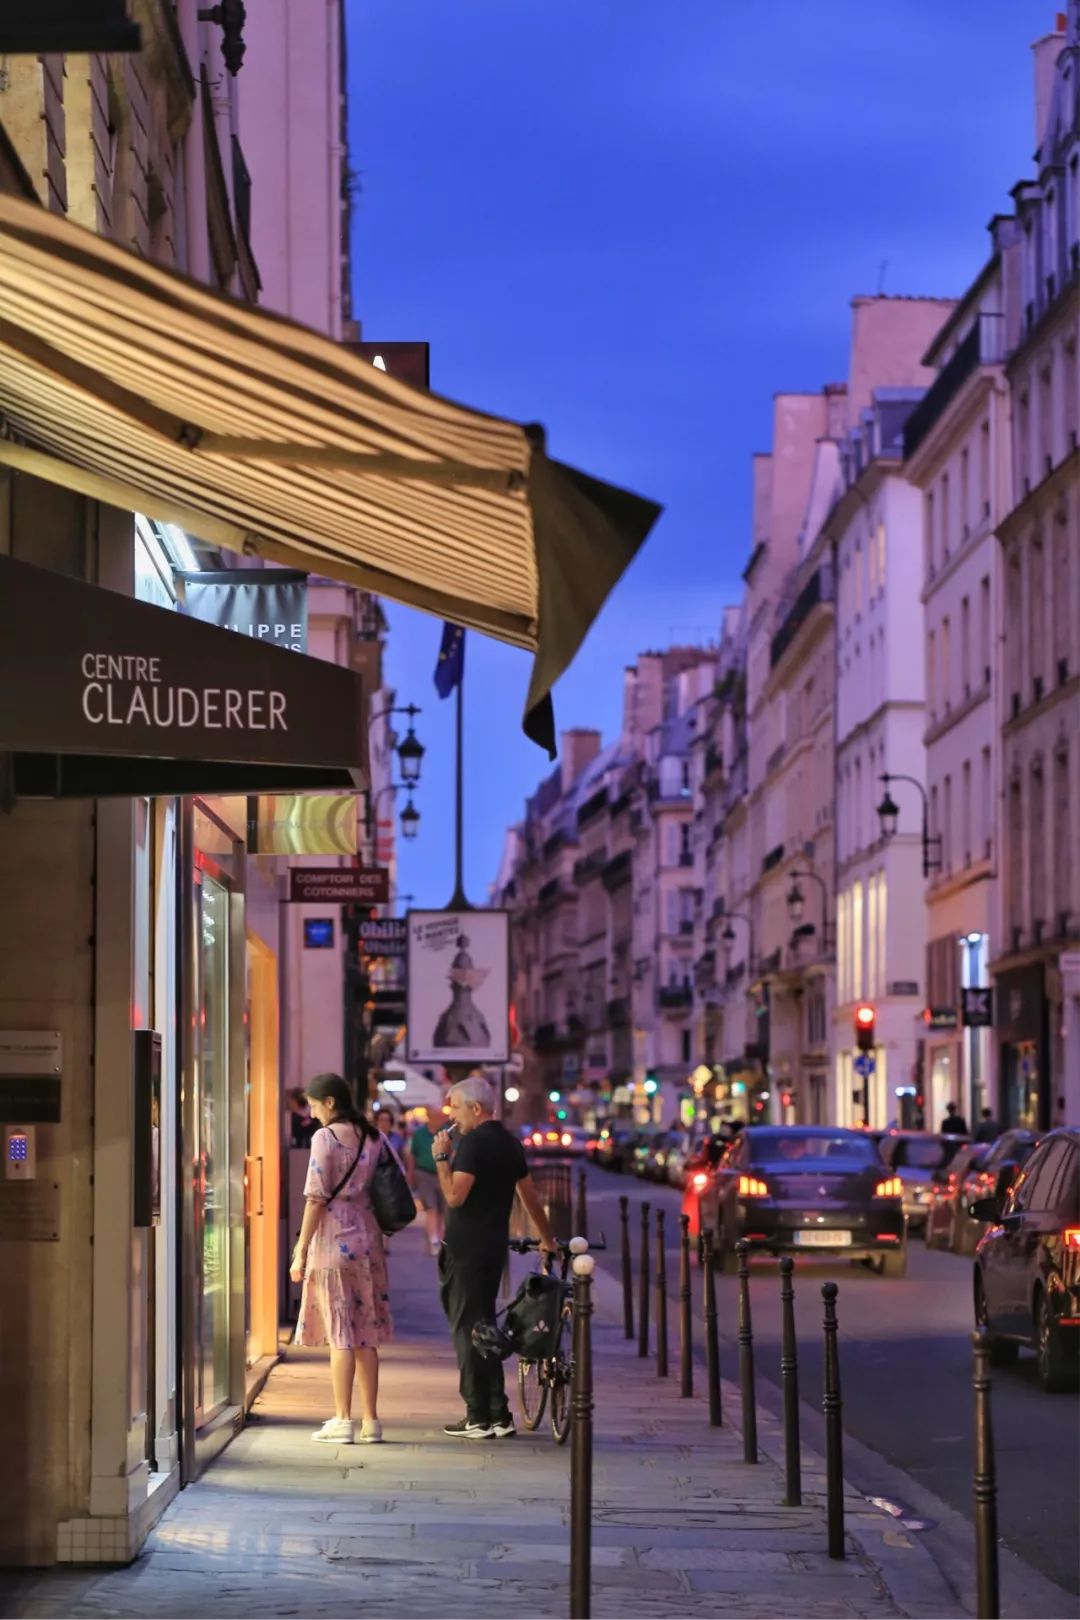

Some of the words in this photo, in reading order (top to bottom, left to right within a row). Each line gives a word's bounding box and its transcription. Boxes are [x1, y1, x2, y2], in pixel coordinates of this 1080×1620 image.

[82, 653, 161, 682] CENTRE
[82, 682, 288, 730] CLAUDERER
[296, 874, 354, 884] COMPTOIR
[360, 874, 382, 884] DES
[303, 887, 375, 897] COTONNIERS
